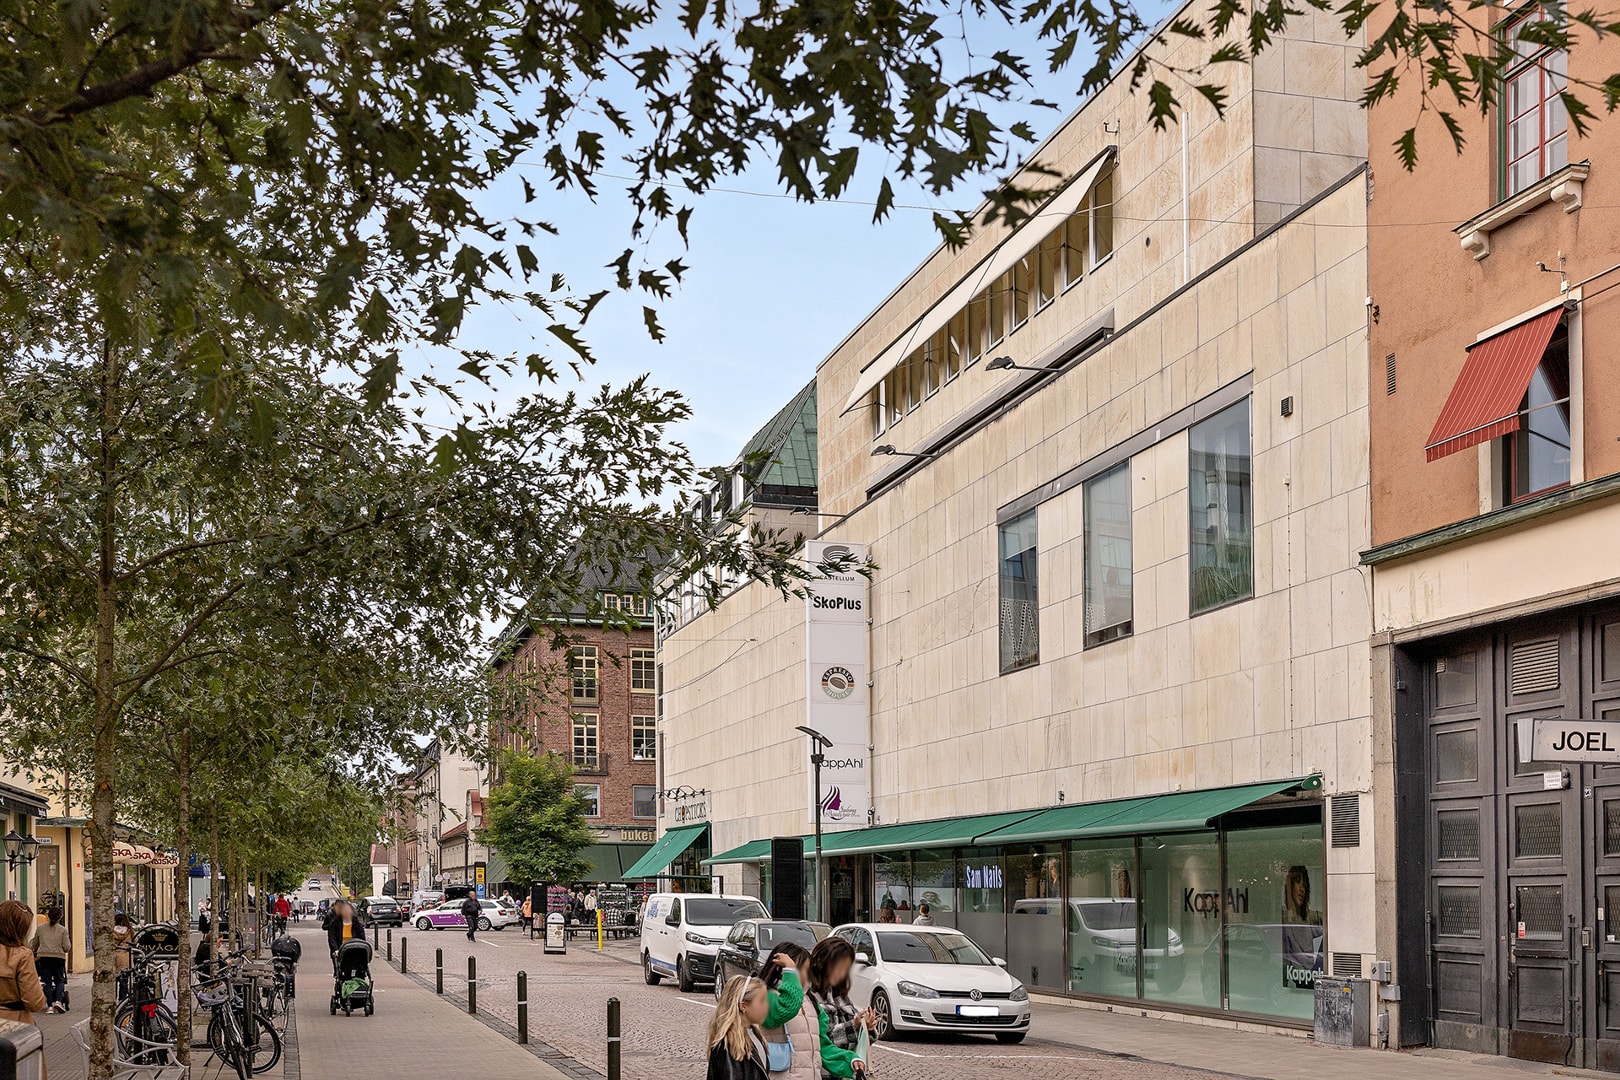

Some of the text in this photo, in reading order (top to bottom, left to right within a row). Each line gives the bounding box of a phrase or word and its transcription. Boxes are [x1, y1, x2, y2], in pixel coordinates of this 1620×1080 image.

[813, 596, 862, 611] SkoPlus
[1552, 731, 1616, 752] JOEL
[819, 758, 864, 770] appAhl
[620, 830, 657, 841] buket
[966, 865, 1003, 889] Sam Nails
